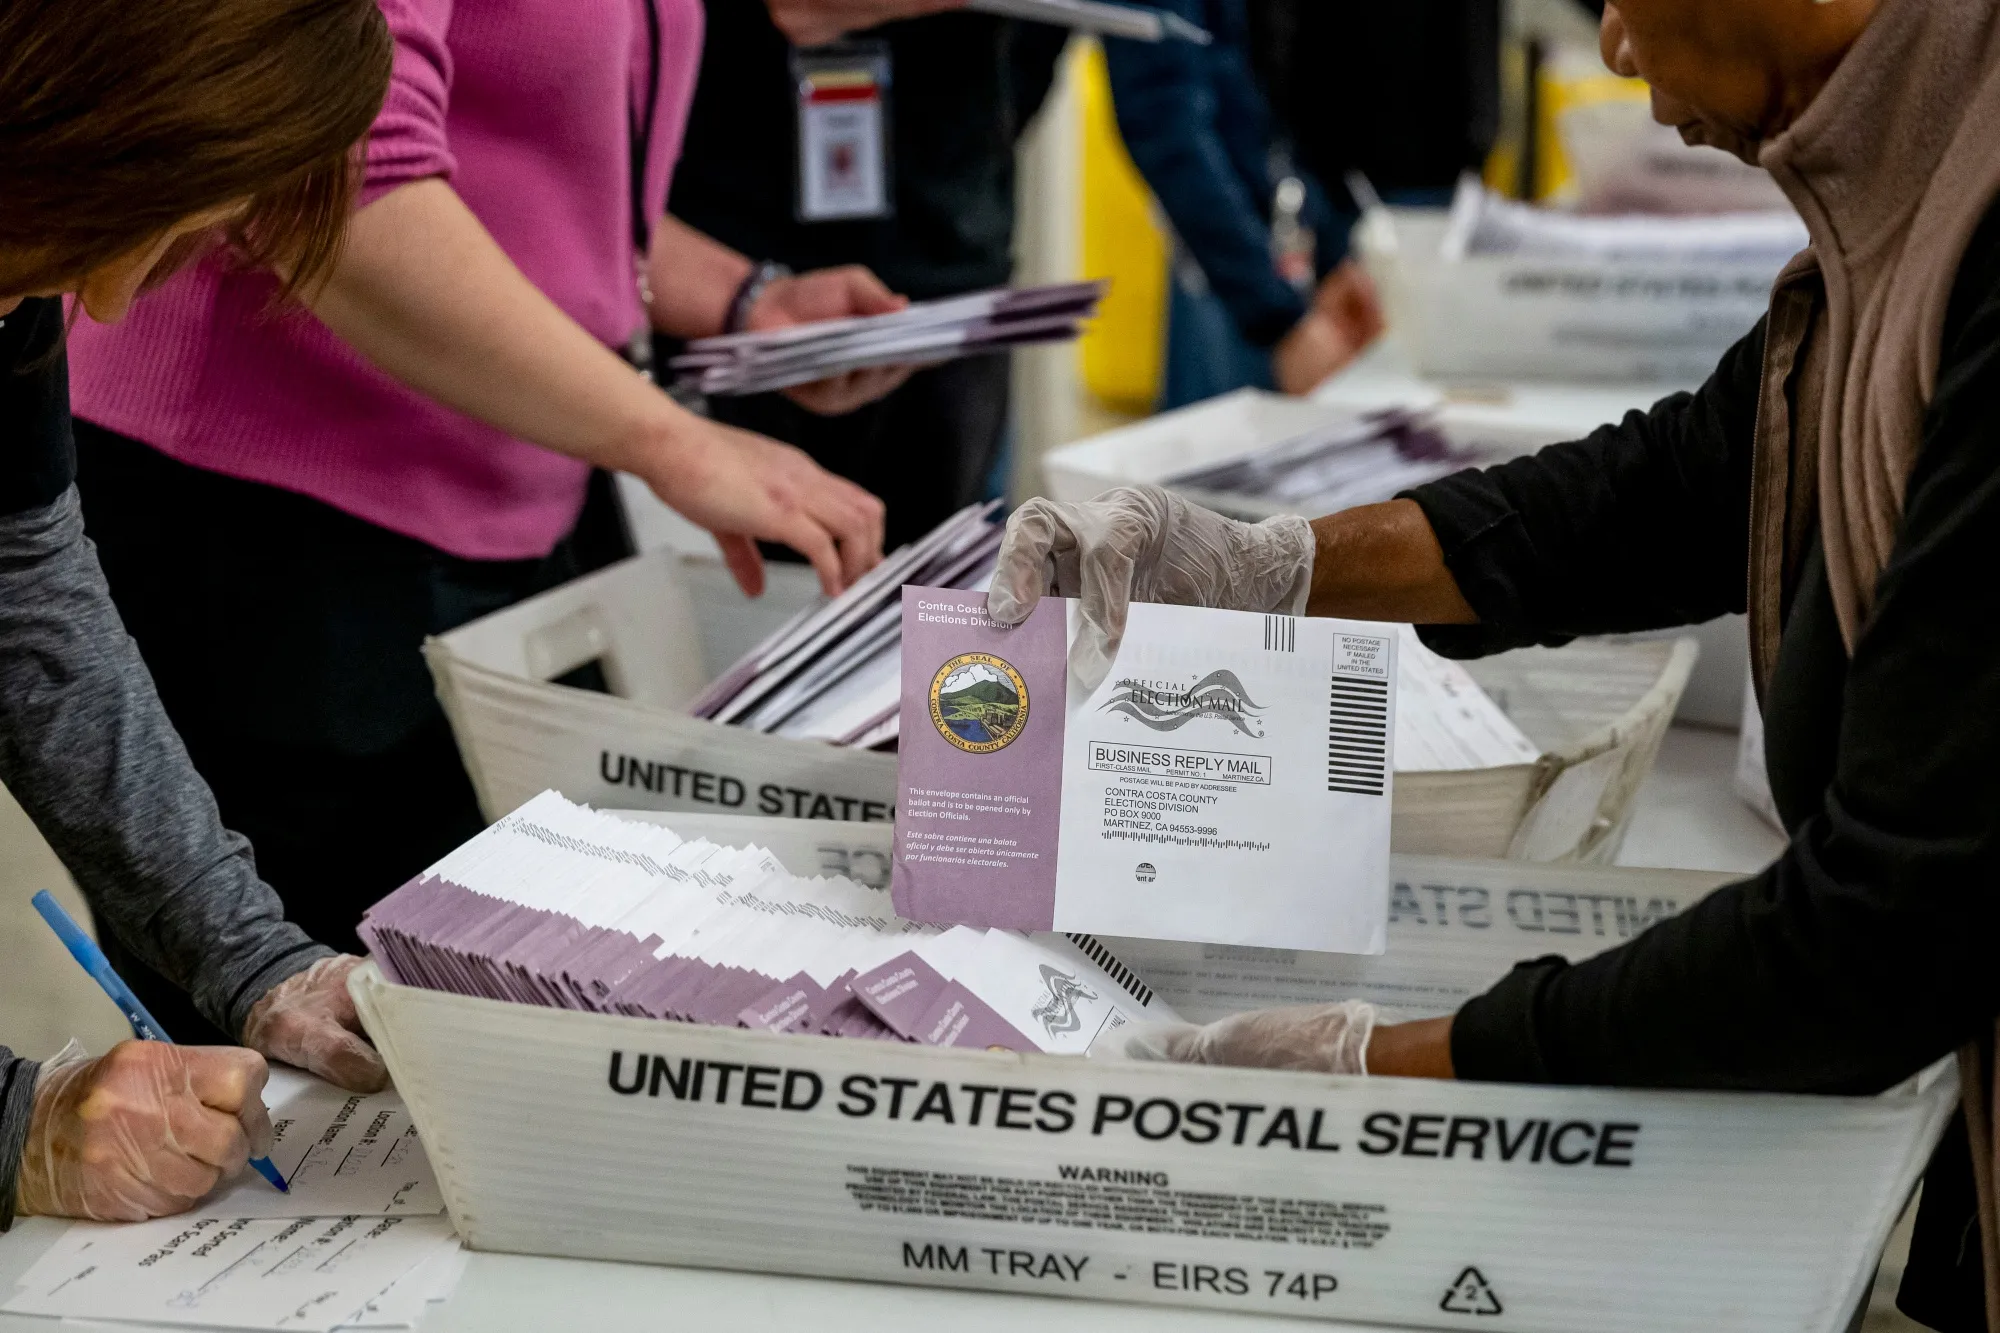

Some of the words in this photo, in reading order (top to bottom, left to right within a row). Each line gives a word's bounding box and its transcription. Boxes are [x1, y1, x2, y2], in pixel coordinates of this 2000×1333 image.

[918, 601, 954, 612] Contra
[957, 604, 988, 614] Costa
[918, 613, 968, 624] Elections
[970, 617, 1014, 630] Division
[1342, 644, 1380, 652] NECESSARY
[1352, 638, 1380, 646] POSTAGE
[948, 658, 962, 670] THE
[970, 655, 992, 664] SEAL
[1000, 662, 1011, 672] OF
[1123, 678, 1187, 691] OFFICIAL
[1131, 690, 1203, 708] ELECTION
[1208, 697, 1244, 713] MAIL
[931, 698, 944, 729] CONTRA
[944, 729, 965, 747] COSTA
[968, 742, 1002, 751] COUNTY
[1002, 705, 1027, 744] CALIFORNIA
[1096, 748, 1171, 766] BUSINESS
[1175, 755, 1224, 771] REPLY
[1227, 760, 1262, 775] MAIL
[1096, 763, 1136, 772] FIRST-CLASS
[1222, 774, 1254, 782] MARTINEZ
[600, 751, 746, 808] UNITED
[757, 783, 896, 822] STATE
[1120, 777, 1148, 785] POSTAGE
[1200, 784, 1237, 792] ADDRESSEE
[909, 788, 924, 796] This
[926, 789, 960, 799] envelope
[961, 792, 992, 801] contains
[1004, 795, 1029, 804] official
[1105, 787, 1144, 798] CONTRA
[1145, 790, 1178, 801] COSTA
[1179, 793, 1218, 805] COUNTY
[908, 798, 930, 807] ballot
[932, 800, 946, 808] and
[976, 804, 1003, 813] opened
[1004, 806, 1020, 816] only
[1022, 807, 1031, 816] by
[1104, 798, 1157, 810] ELECTIONS
[1158, 802, 1199, 813] DIVISION
[1104, 808, 1117, 816] PO
[1120, 809, 1139, 819] BOX
[1141, 812, 1161, 820] 9000
[908, 810, 938, 818] Election
[940, 811, 971, 821] Officials.
[1103, 818, 1153, 831] MARTINEZ,
[1156, 822, 1168, 831] CA
[1169, 824, 1218, 836] 94553-9996
[924, 832, 944, 840] sobre
[946, 834, 977, 843] contiene
[994, 838, 1017, 847] balota
[906, 842, 929, 850] oficial
[936, 844, 954, 852] debe
[968, 847, 995, 856] abierto
[996, 848, 1039, 859] únicamente
[905, 853, 919, 861] por
[919, 854, 965, 864] funcionarios
[967, 858, 1009, 868] electorales.
[334, 1096, 366, 1124] Location
[606, 1050, 824, 1112] UNITED
[836, 1073, 1078, 1135] STATES
[1091, 1094, 1341, 1152] POSTAL
[1358, 1112, 1642, 1167] SERVICE
[364, 1110, 396, 1138] Location
[318, 1124, 348, 1146] Name:
[1058, 1164, 1168, 1188] WARNING
[902, 1242, 970, 1272] MM
[980, 1248, 1090, 1283] TRAY
[1152, 1262, 1250, 1295] EIRS
[1264, 1270, 1339, 1300] 74P
[1465, 1286, 1478, 1300] 2
